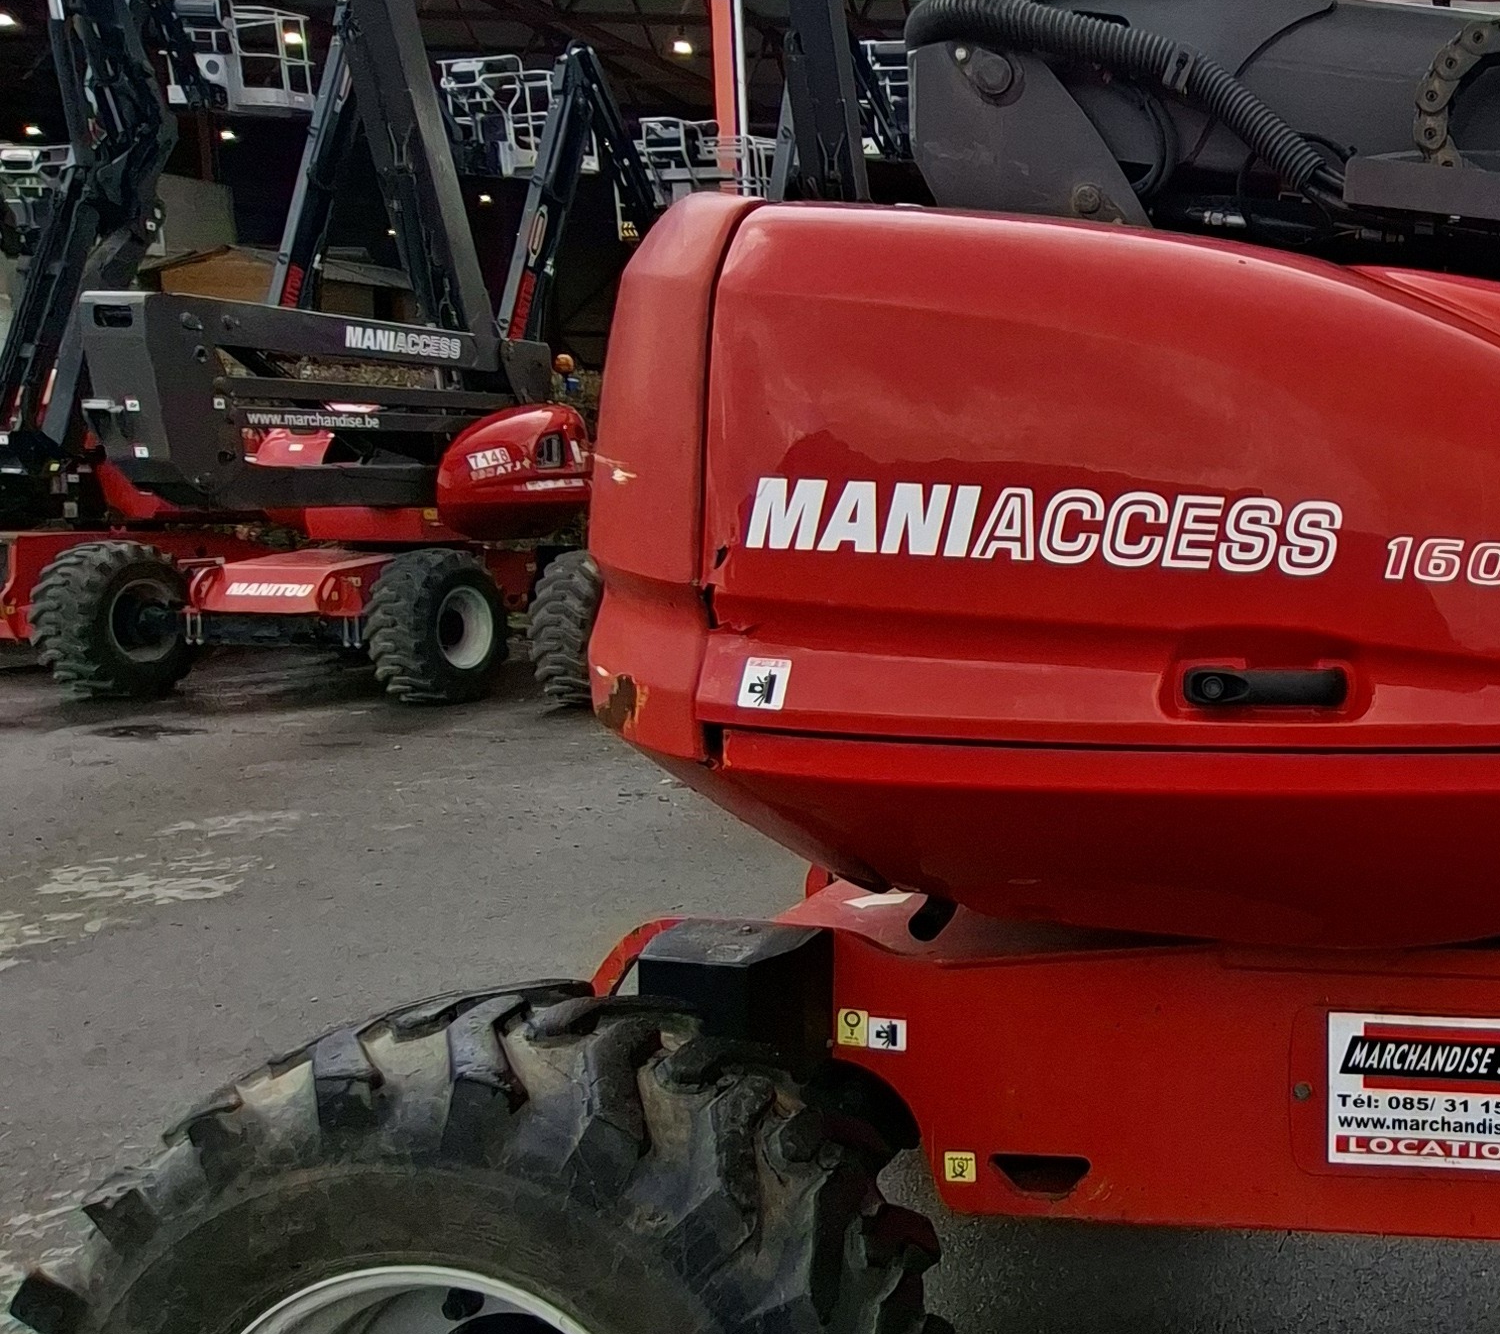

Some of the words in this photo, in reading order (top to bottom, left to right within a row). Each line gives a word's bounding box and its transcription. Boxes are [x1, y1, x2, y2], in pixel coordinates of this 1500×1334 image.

[345, 325, 461, 359] MANIACCESS
[247, 413, 380, 428] www.marchandise.be
[469, 449, 509, 468] 7148
[745, 478, 1343, 575] MANIACCESS
[225, 583, 315, 597] MANITOU
[1348, 1042, 1495, 1075] MARCHANDISE
[1337, 1094, 1380, 1109] Tél:
[1387, 1096, 1436, 1111] 085/
[1443, 1098, 1469, 1113] 31
